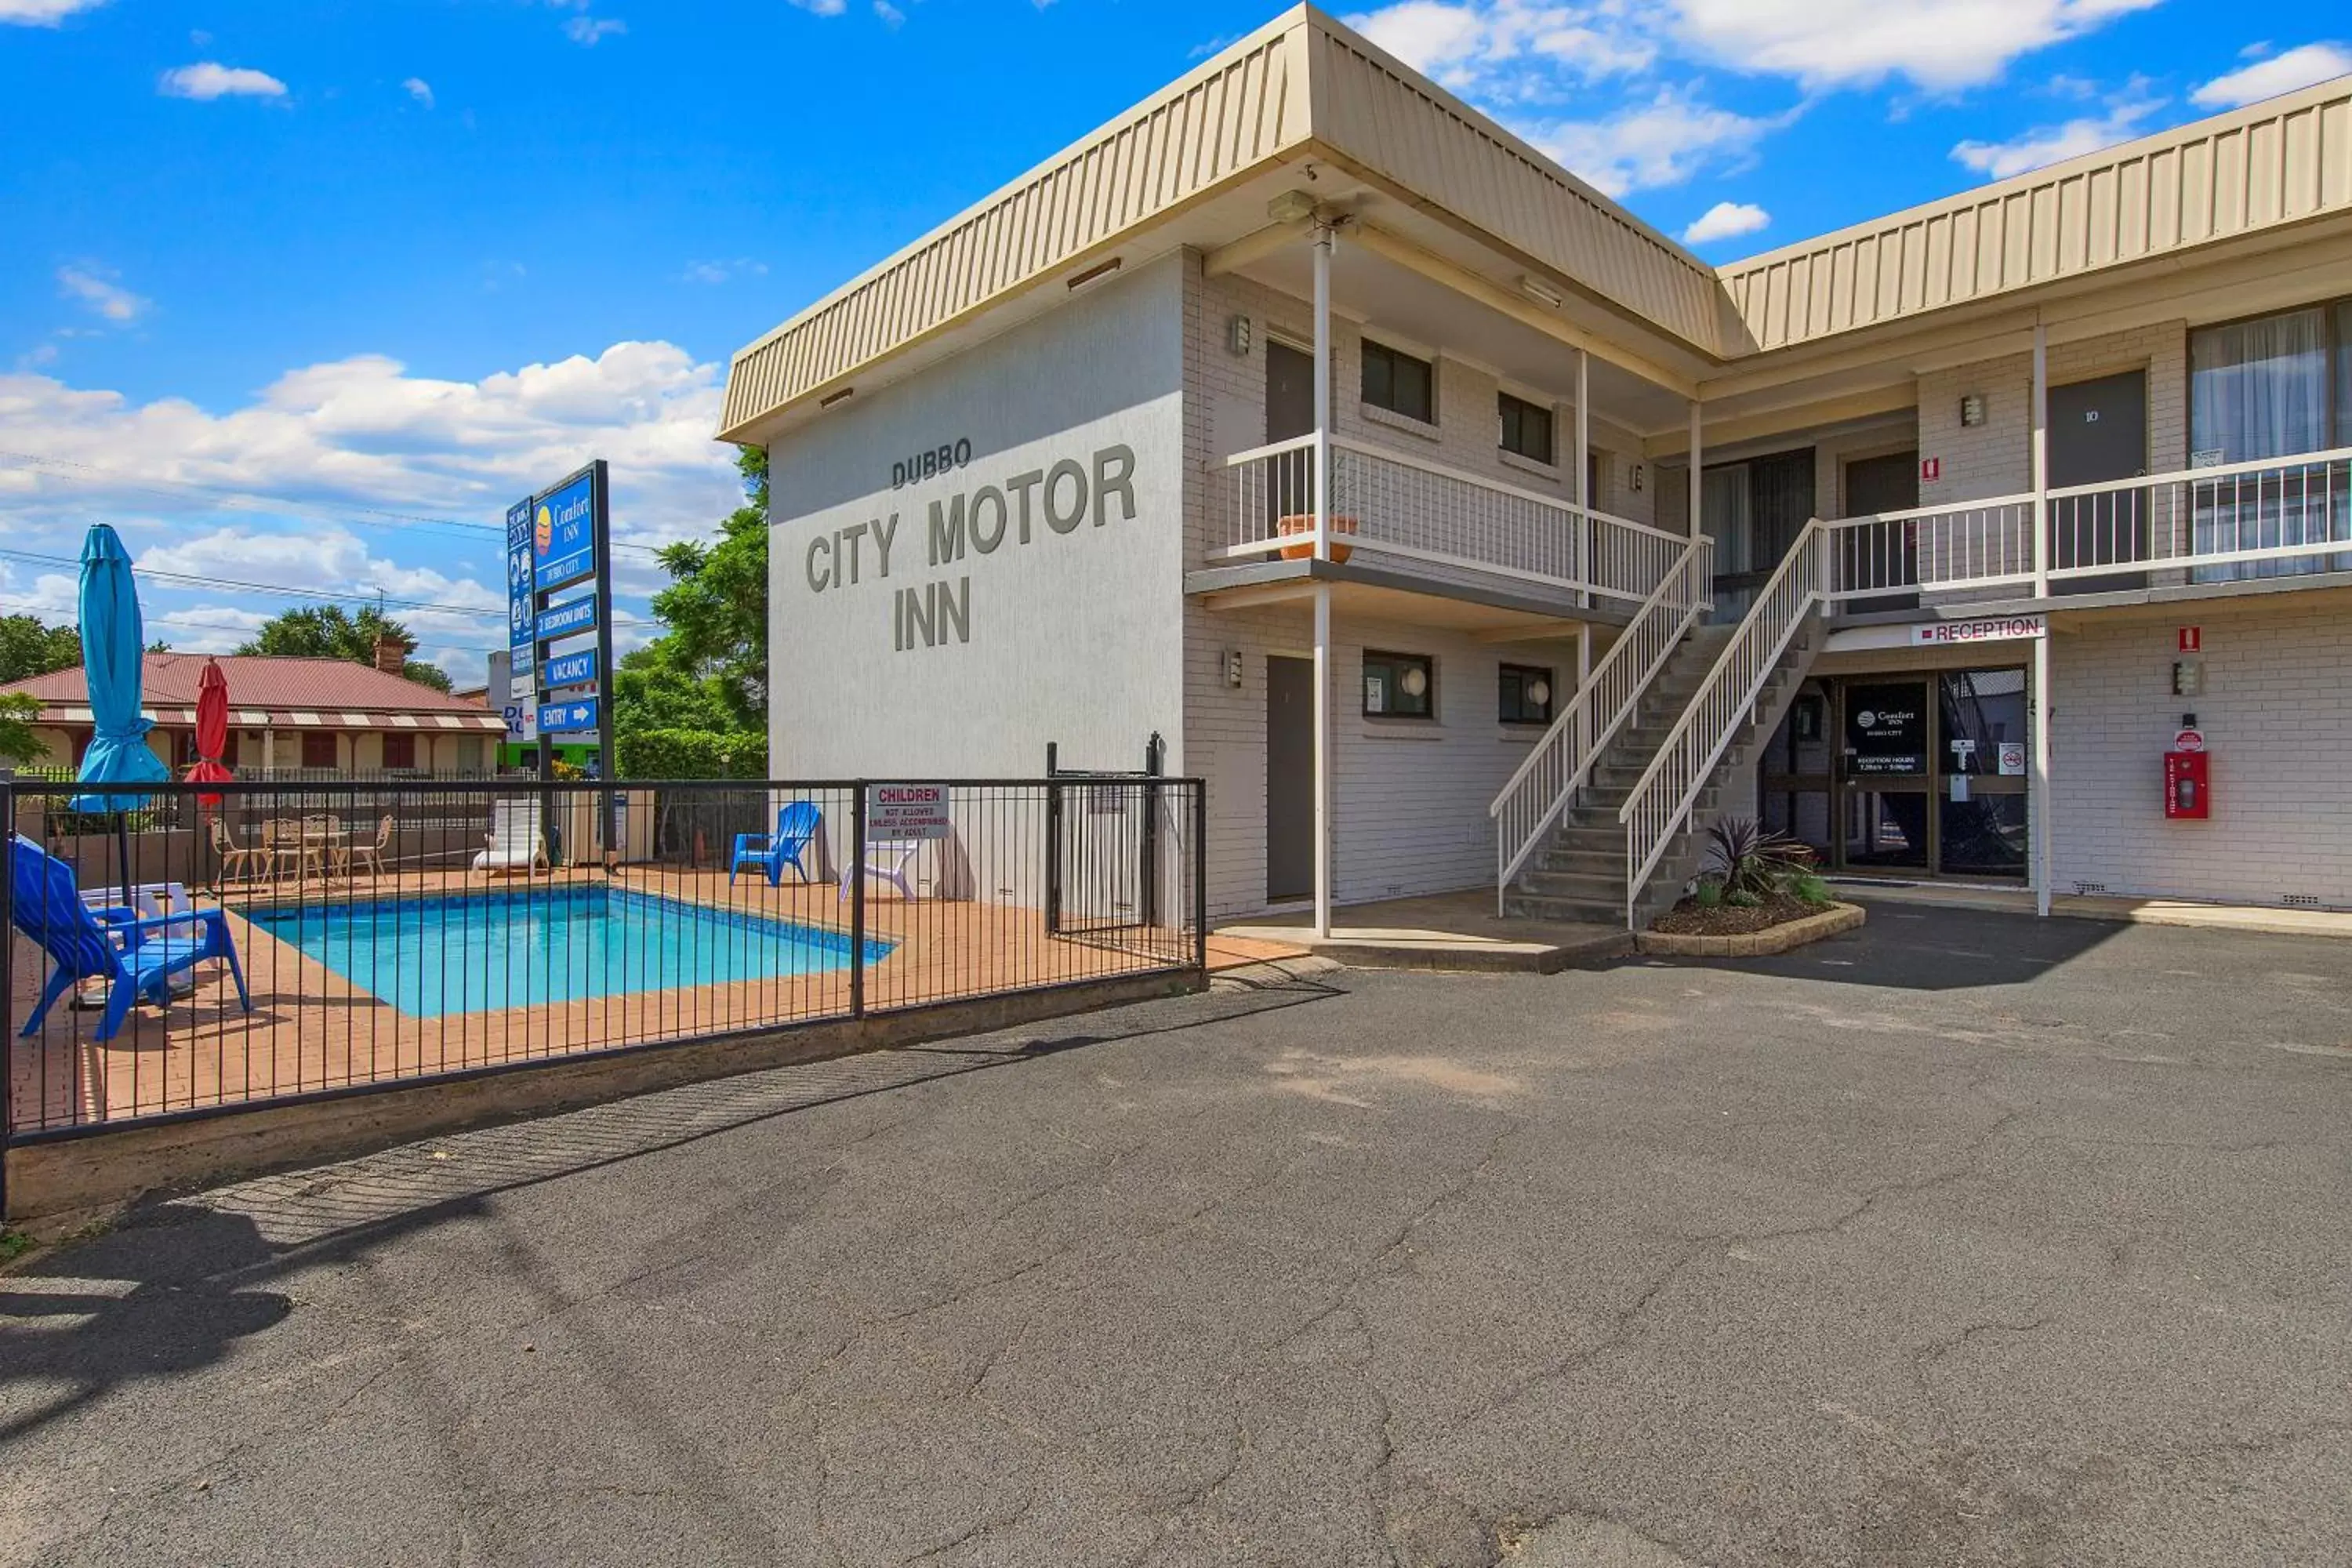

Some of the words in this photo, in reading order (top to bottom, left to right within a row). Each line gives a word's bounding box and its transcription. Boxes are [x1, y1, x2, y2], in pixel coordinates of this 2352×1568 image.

[2086, 411, 2099, 423] 10
[892, 437, 972, 491] DUBBO
[554, 496, 590, 528] Comfort
[806, 512, 900, 593] CITY
[927, 443, 1137, 567] MOTOR
[564, 521, 579, 543] INN
[544, 609, 574, 631] BEDROOM
[894, 576, 971, 652] INN
[1936, 618, 2040, 641] RECEPTION
[552, 657, 589, 681] VACANCY
[543, 708, 567, 726] ENTRY
[1878, 711, 1915, 720] Comfort
[879, 788, 940, 803] CHILDREN
[902, 807, 935, 816] ALLOWED
